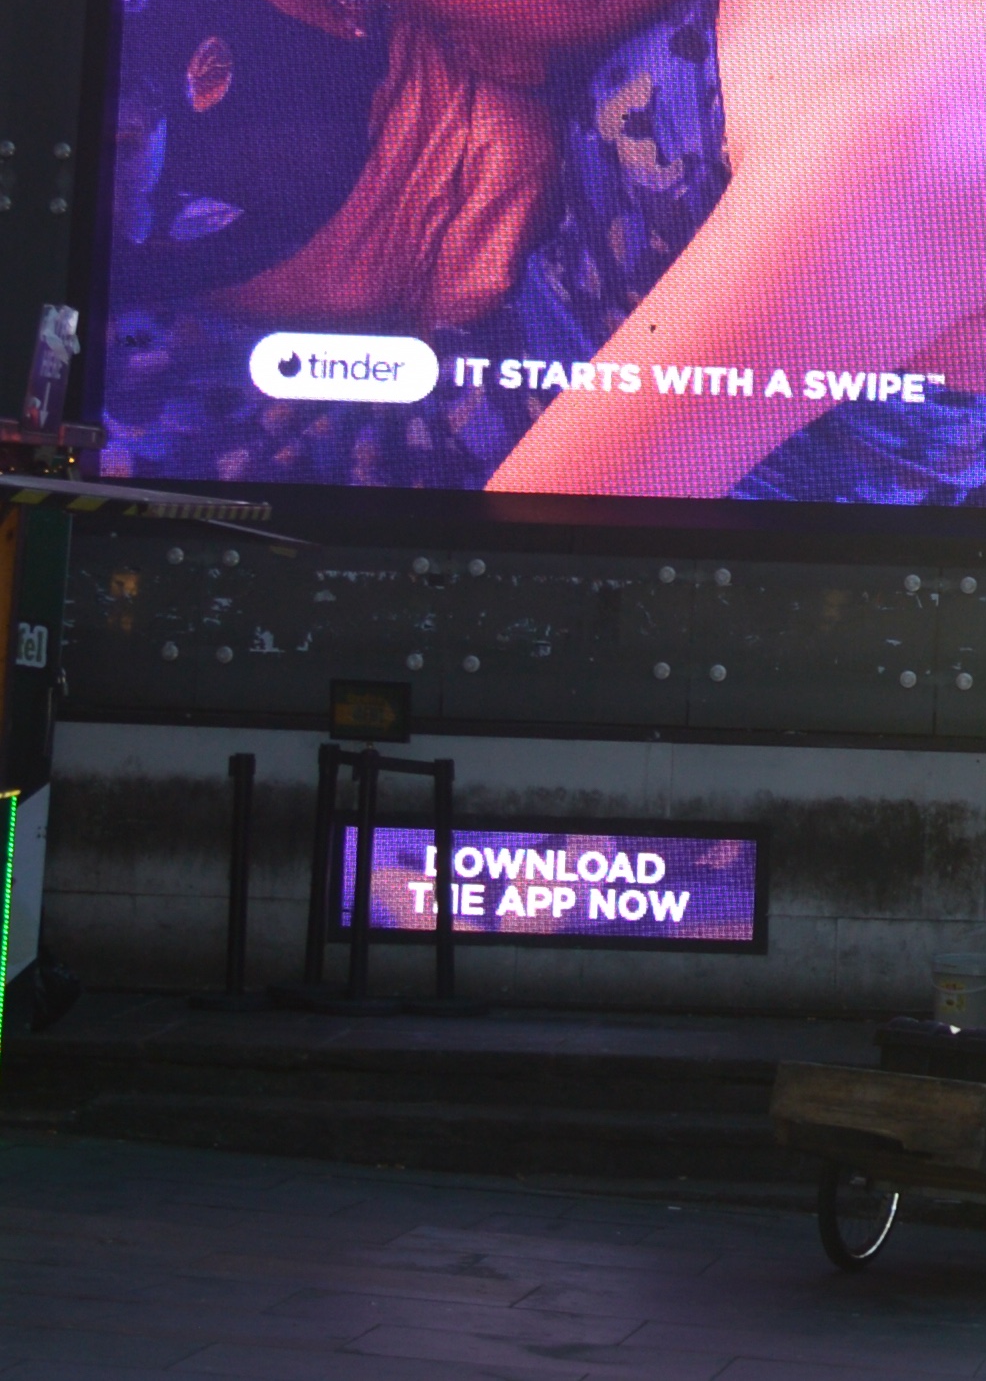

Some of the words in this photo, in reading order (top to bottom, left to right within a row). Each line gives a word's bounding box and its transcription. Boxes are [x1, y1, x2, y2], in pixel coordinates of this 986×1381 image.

[308, 351, 405, 381] tinder
[454, 357, 490, 387] IT
[499, 359, 643, 394] STARTS
[652, 364, 754, 397] WITH
[764, 369, 793, 398] A
[496, 884, 576, 918] APP
[588, 888, 690, 923] NOW
